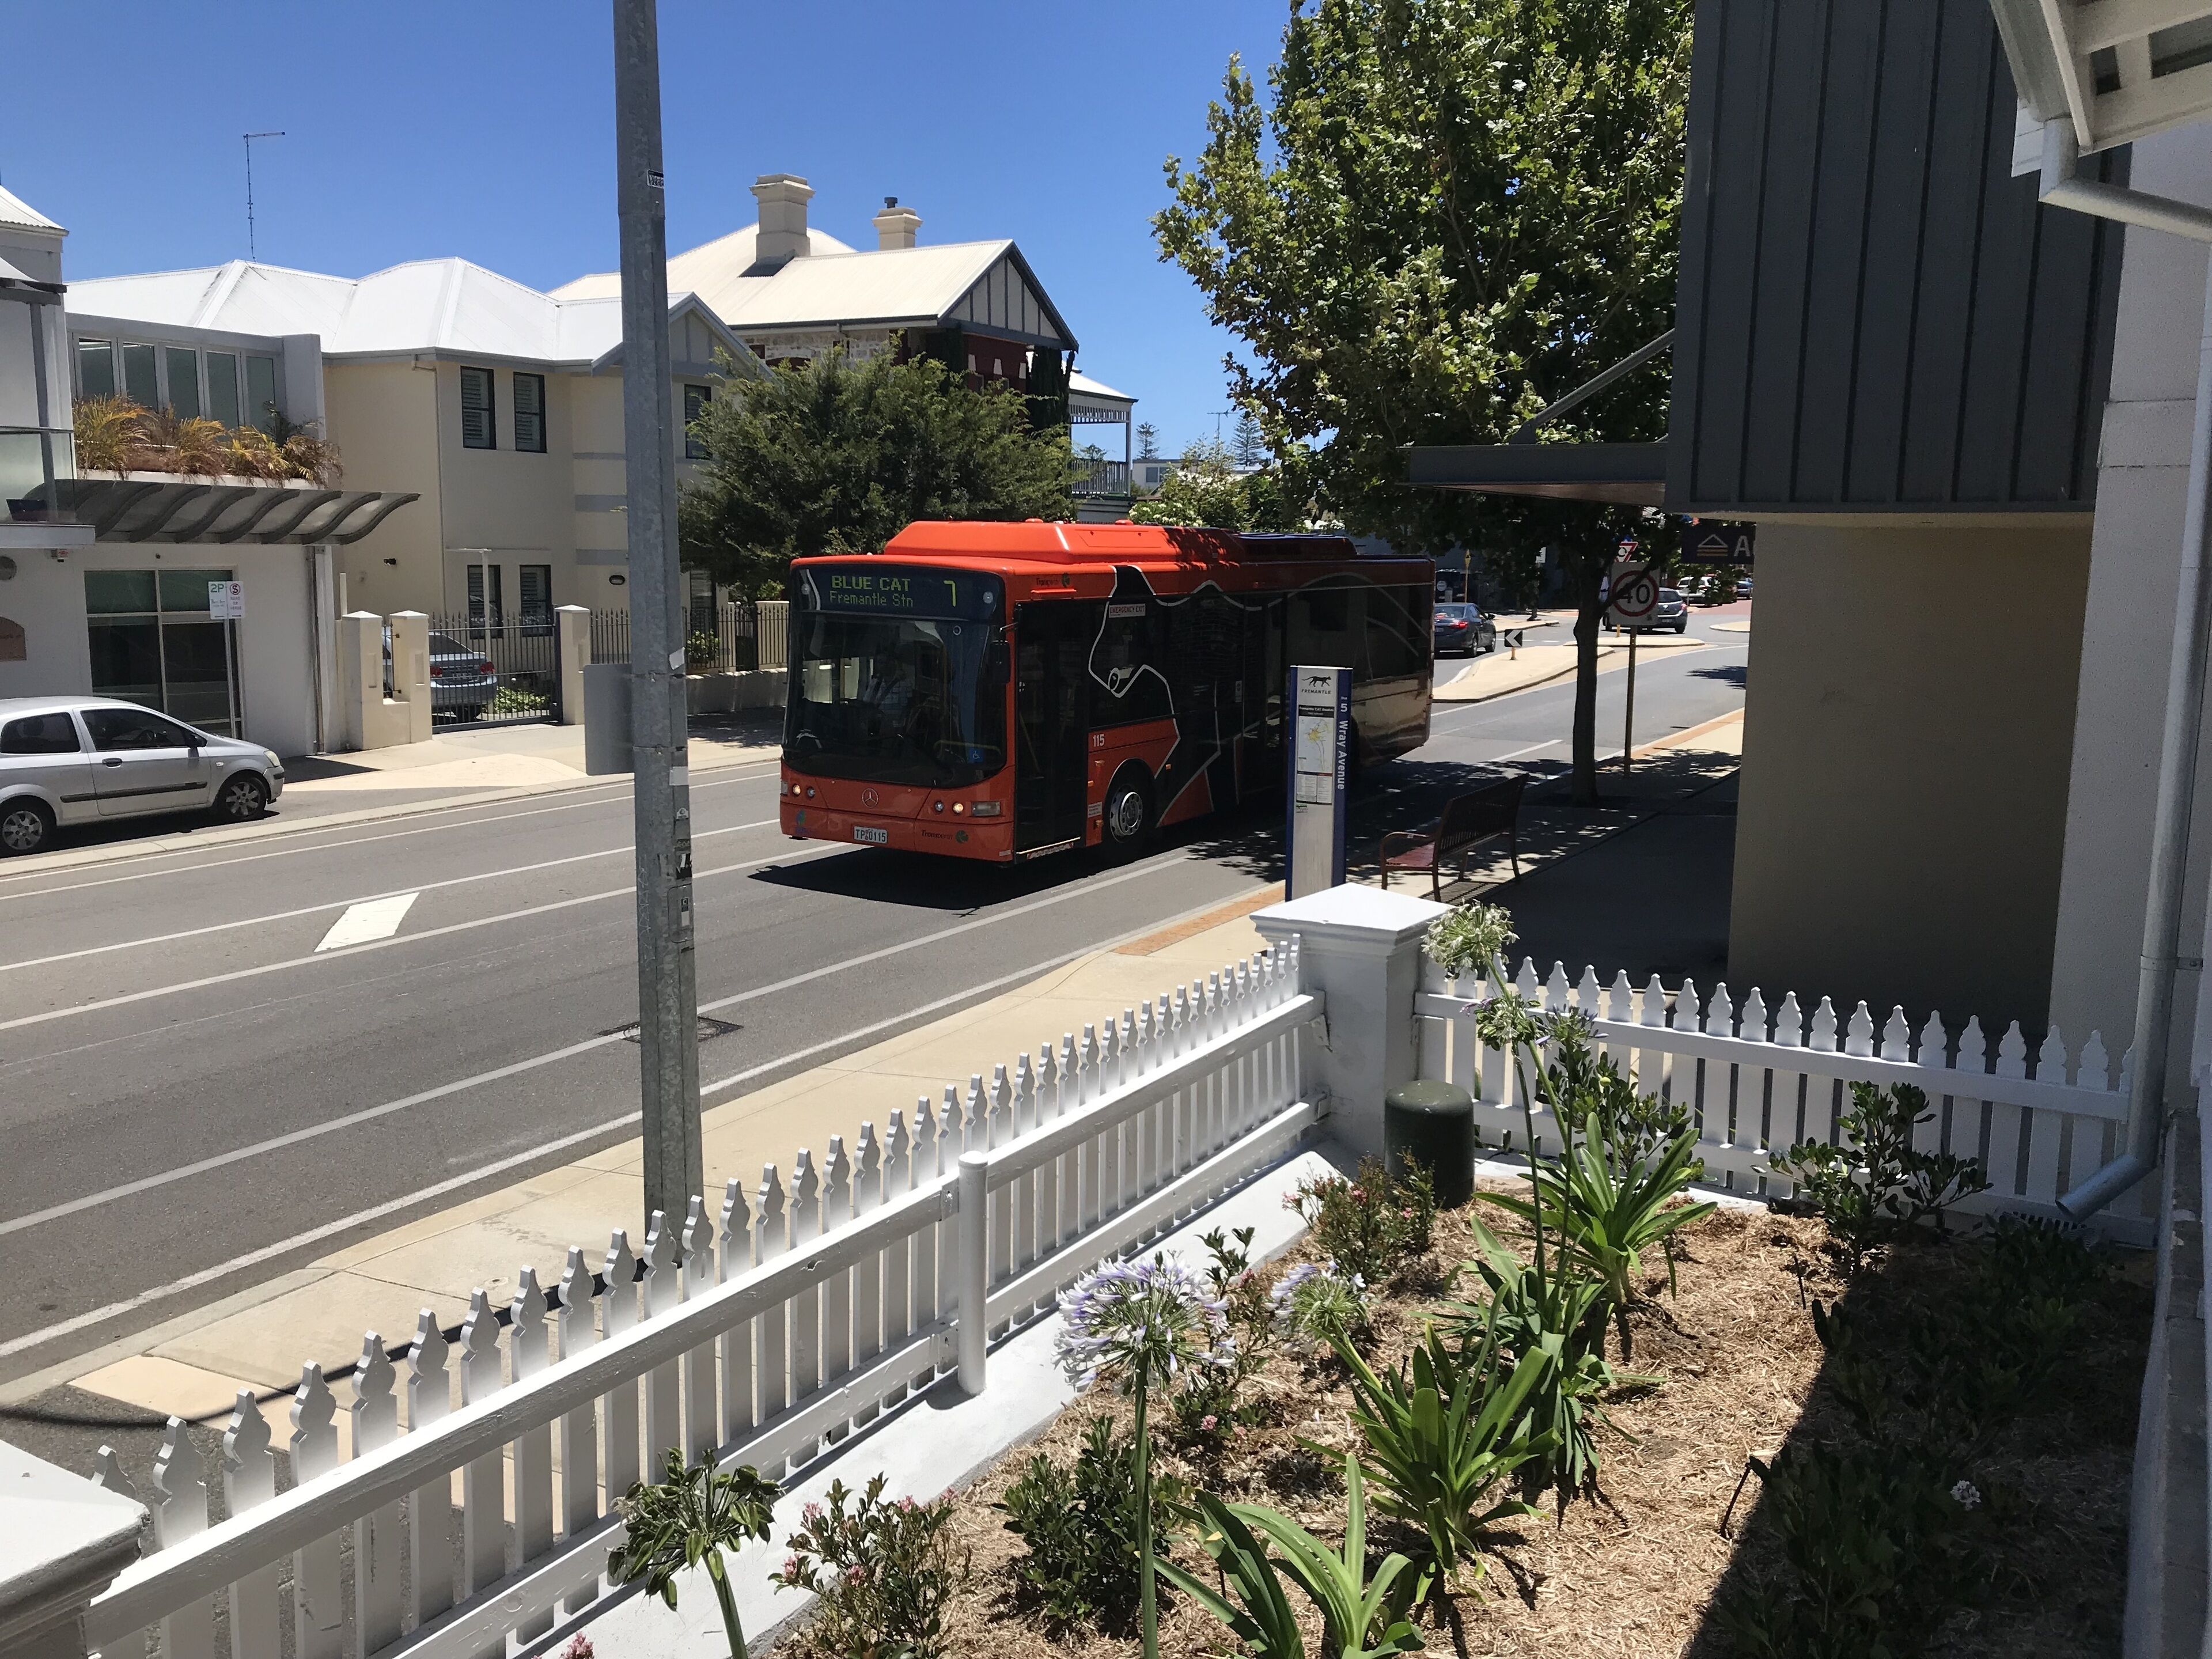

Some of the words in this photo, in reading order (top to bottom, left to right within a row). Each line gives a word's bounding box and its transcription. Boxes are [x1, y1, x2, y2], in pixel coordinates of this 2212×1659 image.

[210, 583, 224, 593] 2P
[831, 575, 872, 590] BLUE
[879, 577, 911, 592] CAT
[830, 591, 887, 606] Fremantle
[892, 593, 914, 608] Stn
[944, 580, 956, 607] 7
[1340, 703, 1348, 712] 5
[1093, 733, 1105, 747] 115
[1336, 721, 1349, 747] Wray
[1338, 751, 1347, 790] Avenue
